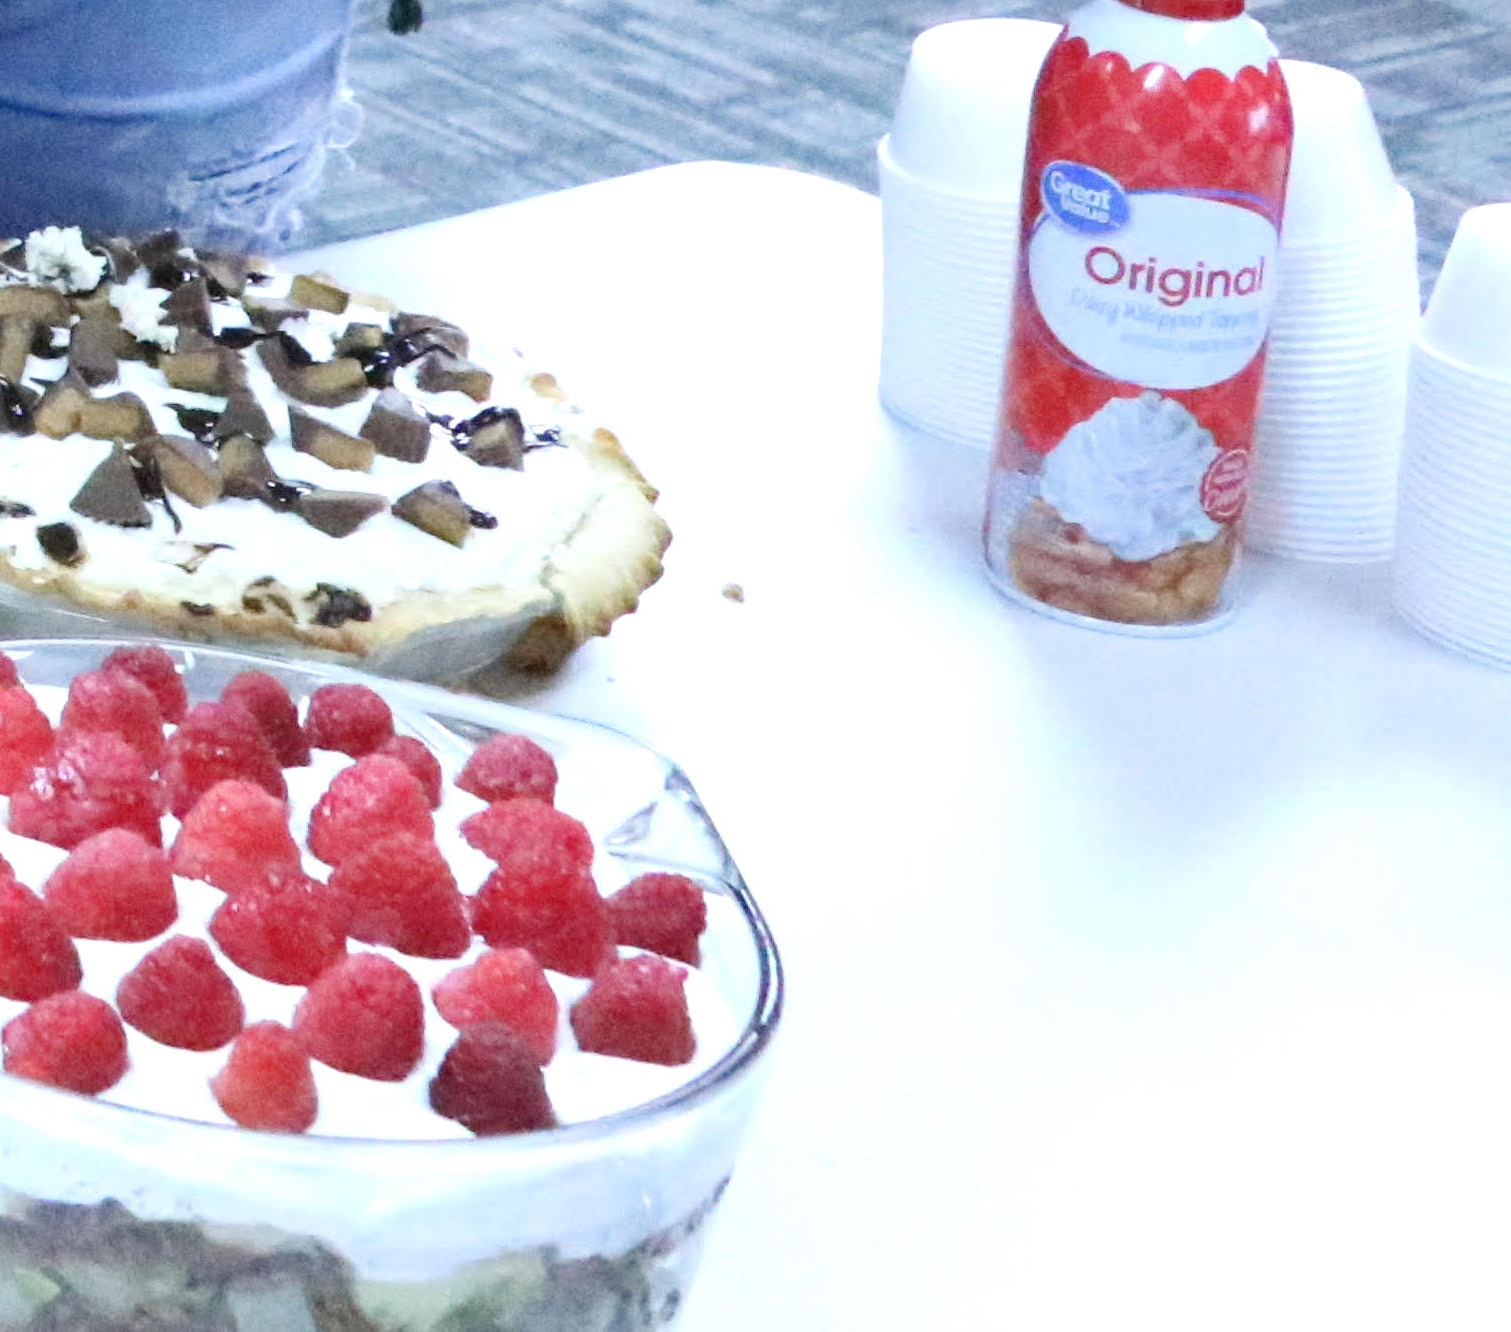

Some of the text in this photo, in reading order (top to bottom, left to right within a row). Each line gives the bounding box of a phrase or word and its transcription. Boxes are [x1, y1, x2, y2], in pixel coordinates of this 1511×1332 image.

[1050, 170, 1114, 212] Great
[1061, 193, 1110, 224] Value
[1084, 246, 1266, 307] Original
